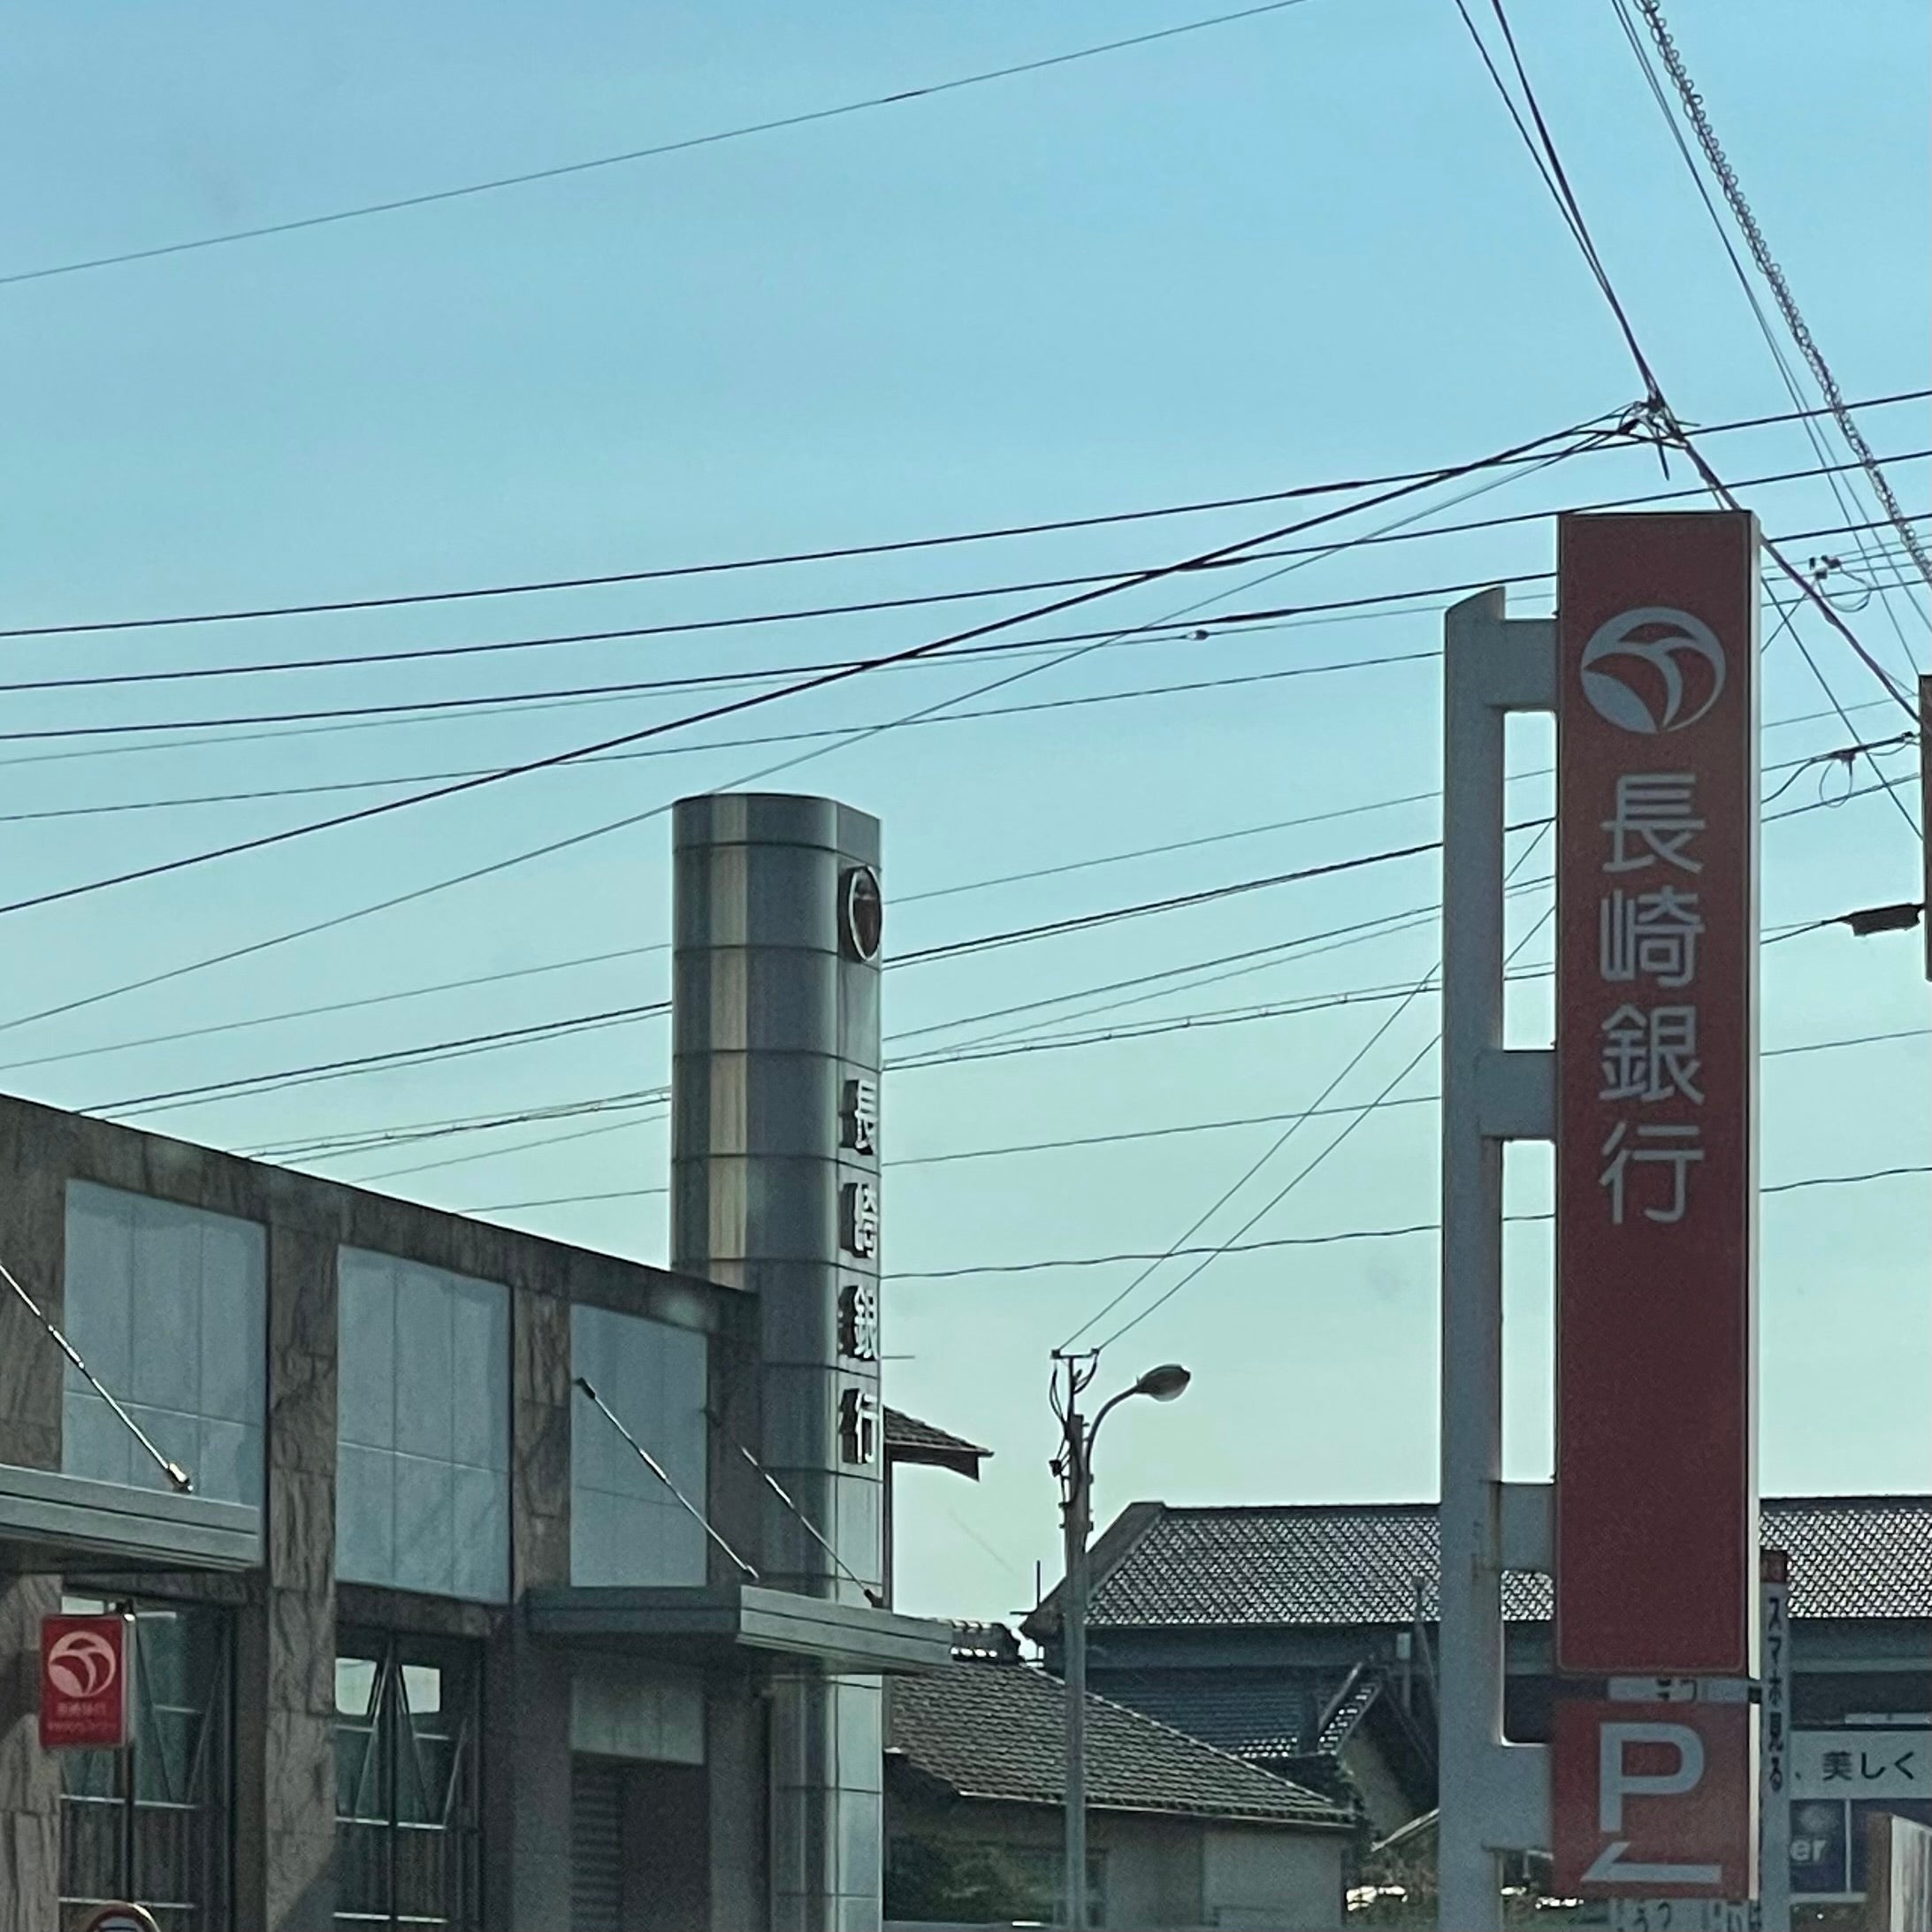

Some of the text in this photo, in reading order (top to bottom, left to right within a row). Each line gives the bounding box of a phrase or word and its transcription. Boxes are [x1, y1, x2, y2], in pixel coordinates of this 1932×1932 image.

[1598, 773, 1707, 1225] 長崎銀行
[1599, 1722, 1706, 1833] P
